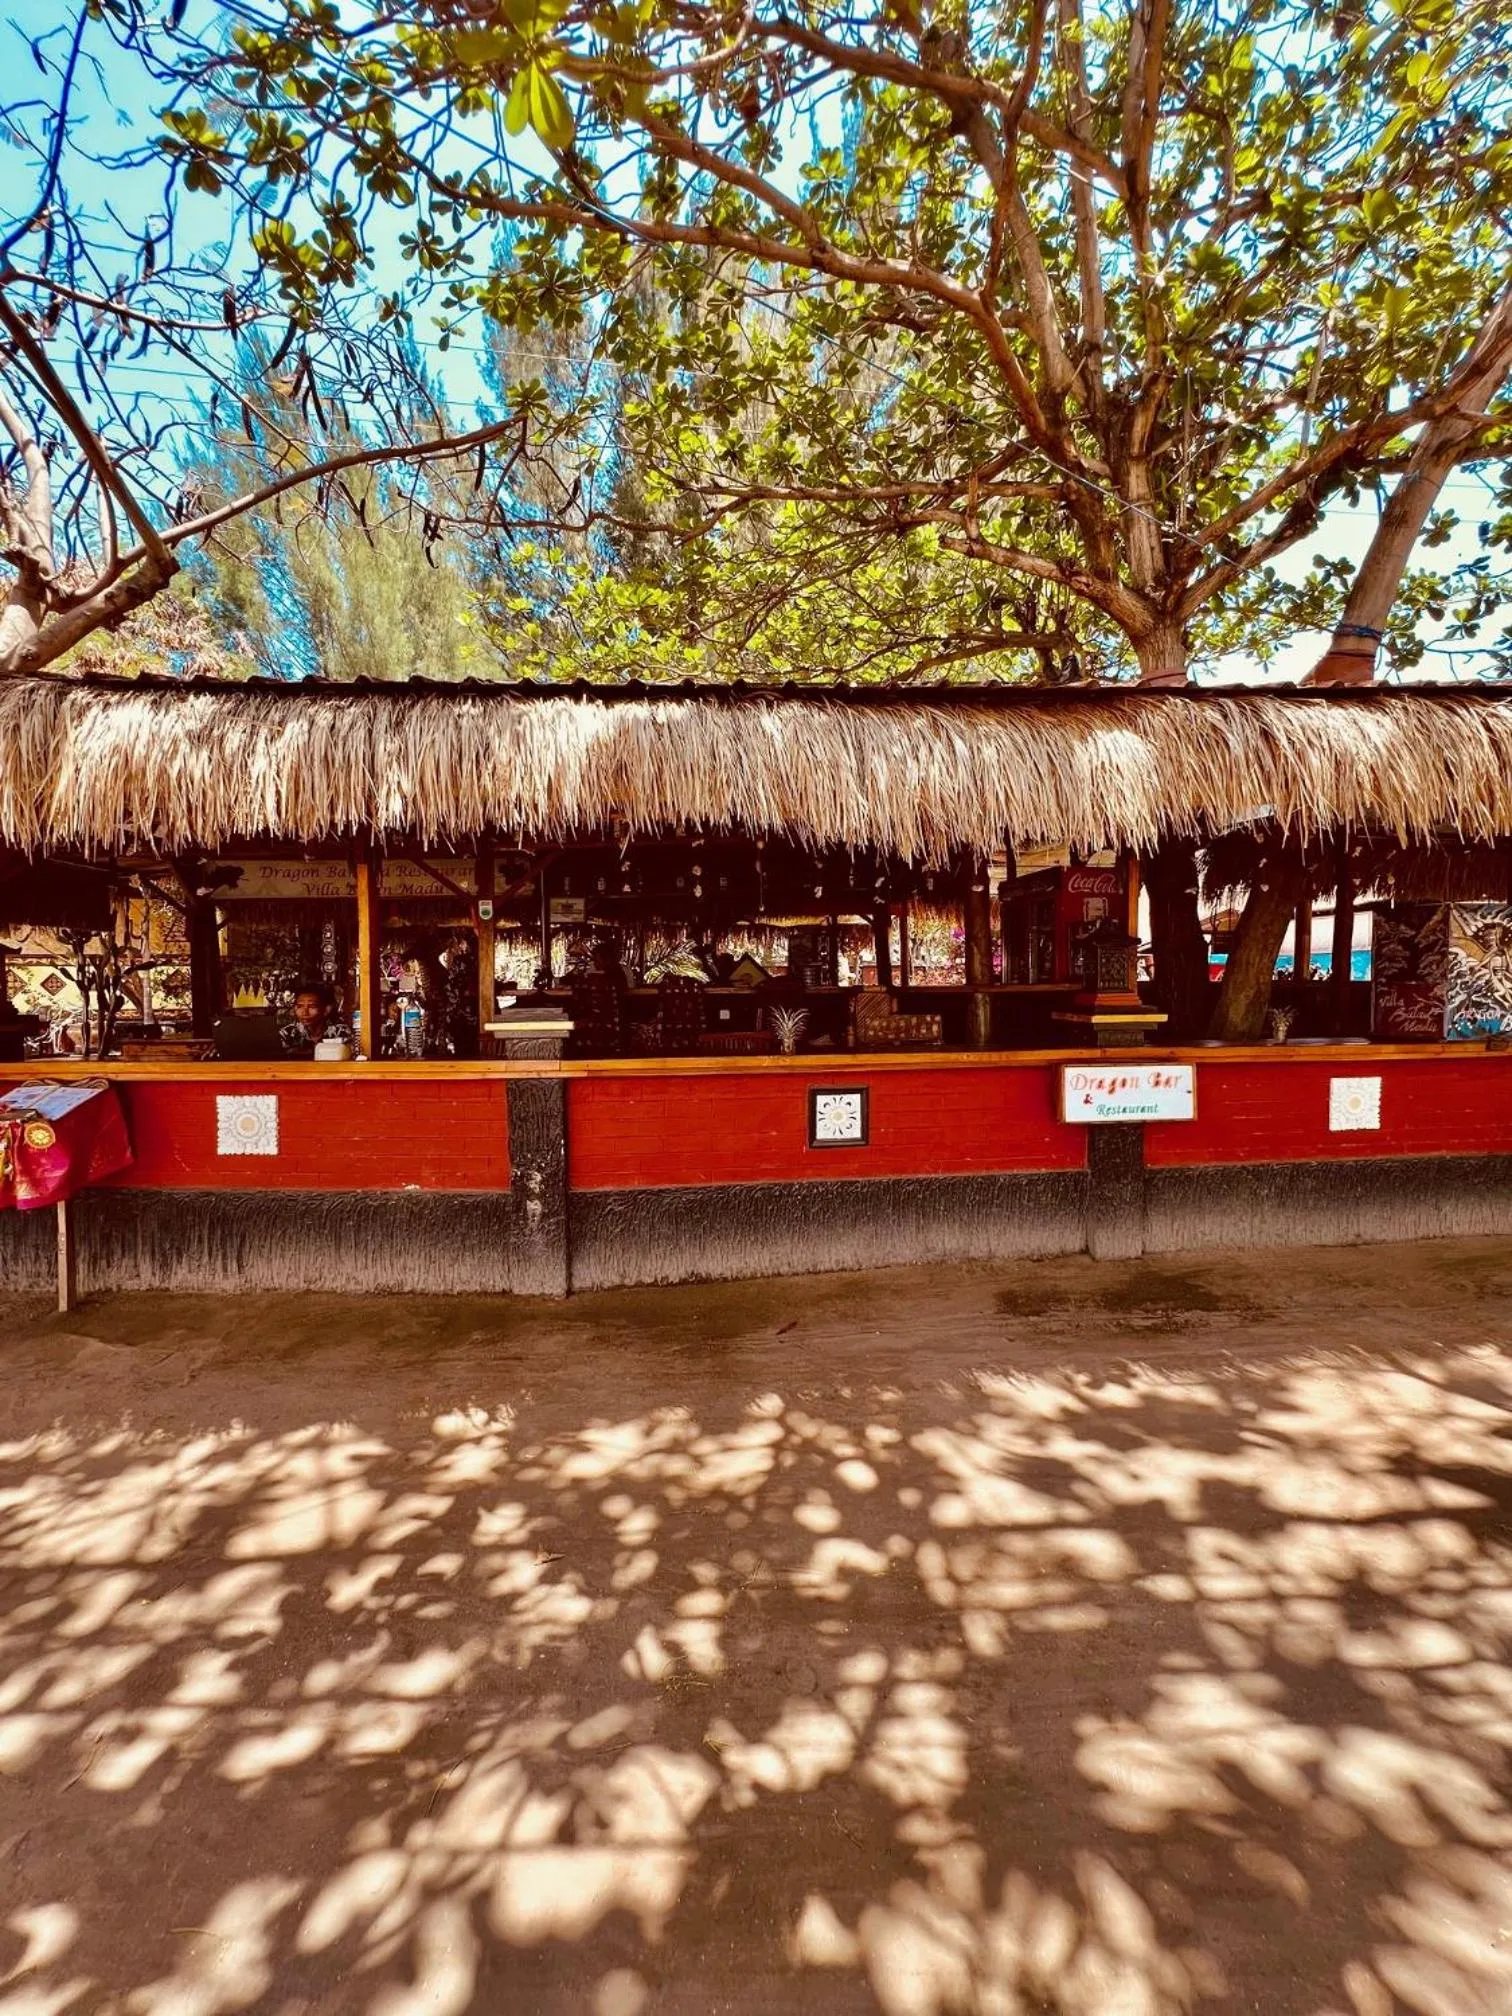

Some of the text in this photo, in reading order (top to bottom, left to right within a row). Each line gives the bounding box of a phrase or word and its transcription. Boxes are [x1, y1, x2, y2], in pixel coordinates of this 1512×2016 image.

[259, 865, 320, 881] Dragon
[303, 882, 339, 896] Villa
[1070, 1071, 1183, 1095] Dragon Bar
[1083, 1094, 1094, 1105] &
[1097, 1104, 1159, 1117] Restaurant
